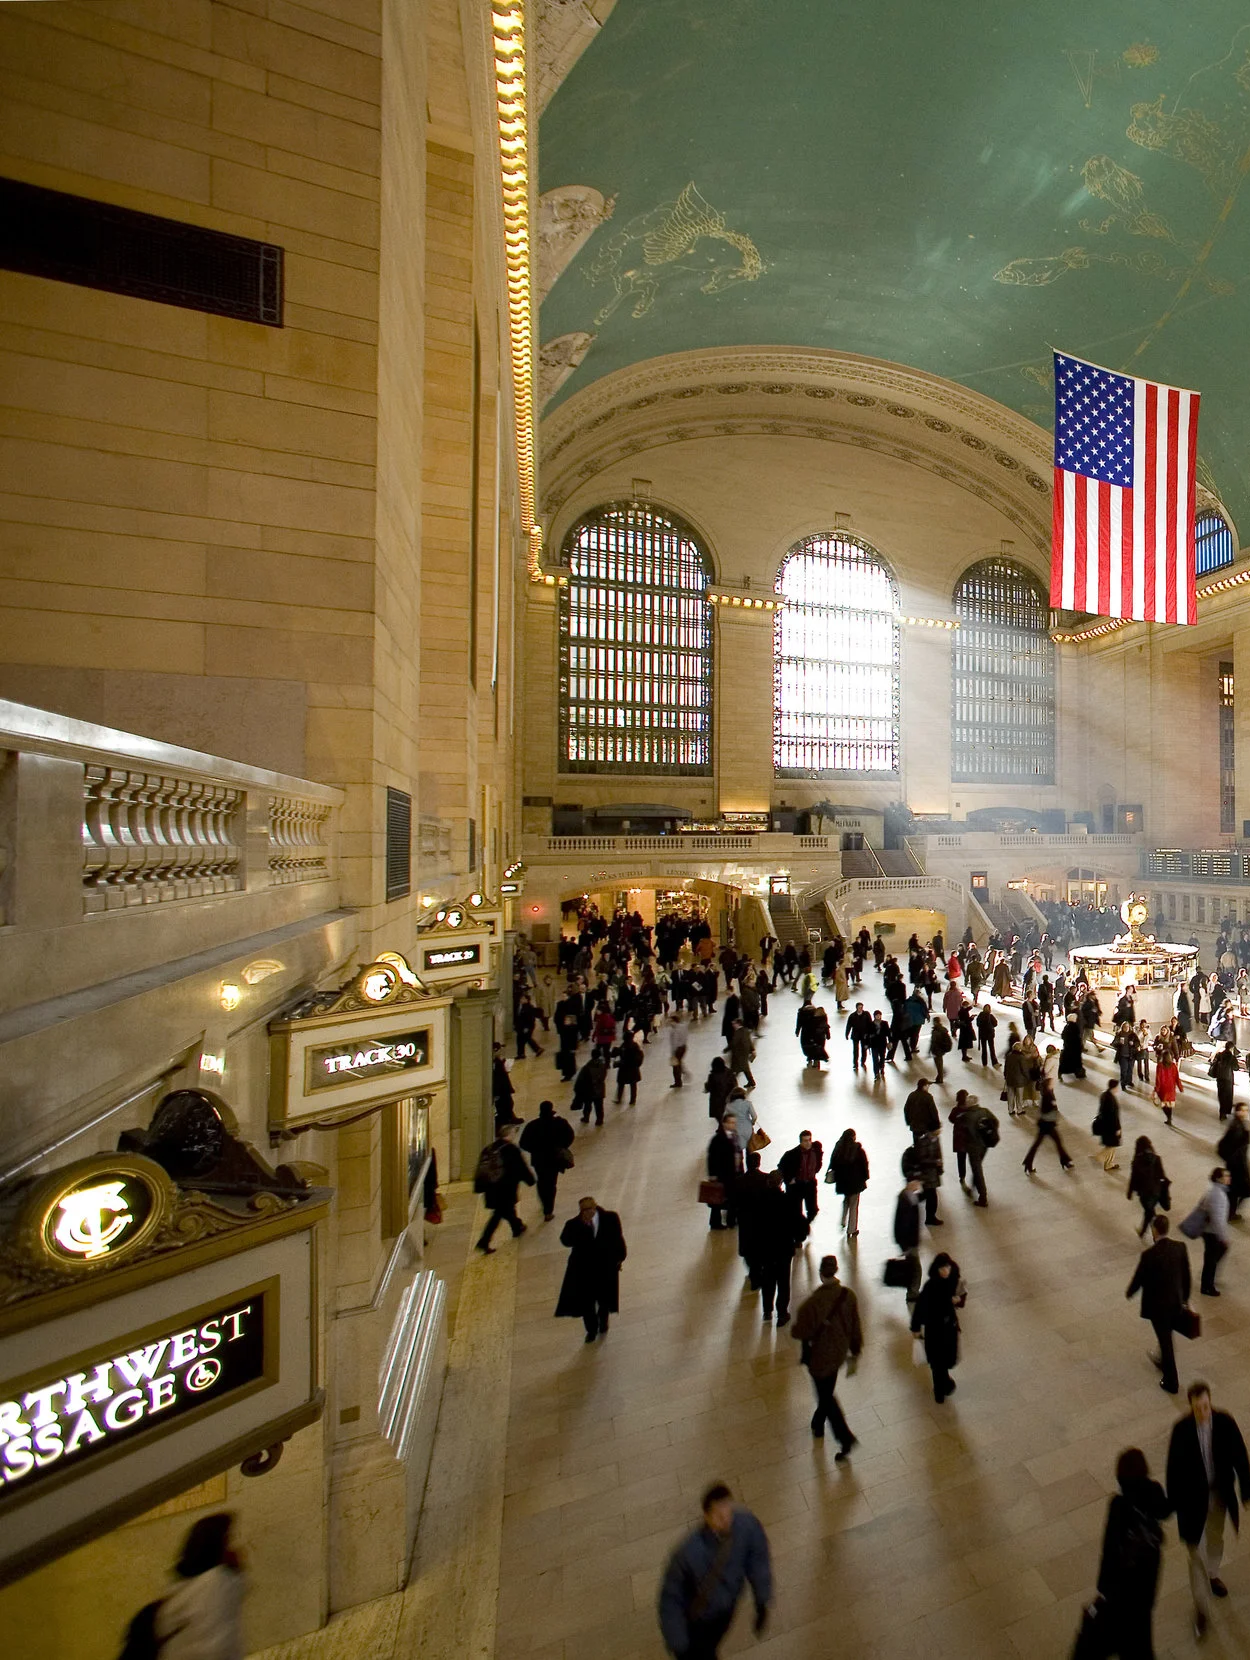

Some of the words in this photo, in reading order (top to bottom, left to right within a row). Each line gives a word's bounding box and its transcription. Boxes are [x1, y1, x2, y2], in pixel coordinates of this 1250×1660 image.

[429, 952, 461, 964] TRACK
[325, 1045, 393, 1074] TRACK
[393, 1042, 416, 1059] 30
[0, 1373, 177, 1486] SSAGE
